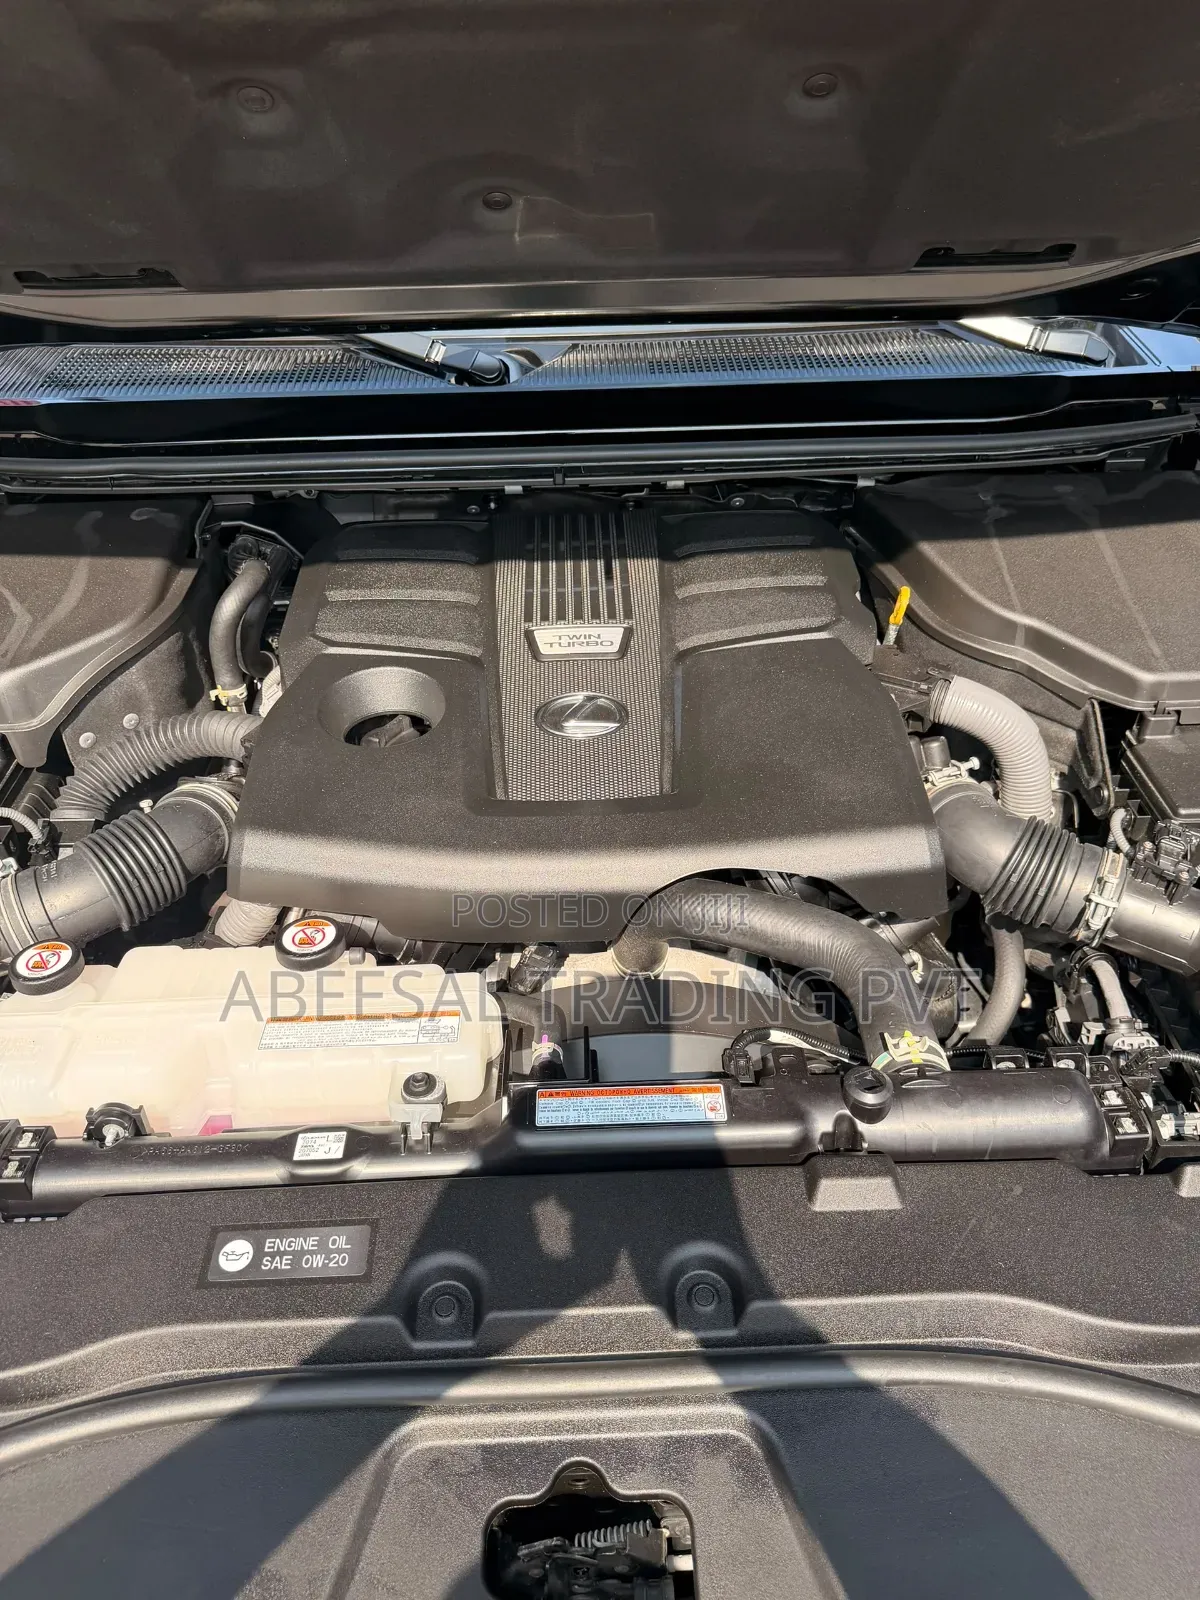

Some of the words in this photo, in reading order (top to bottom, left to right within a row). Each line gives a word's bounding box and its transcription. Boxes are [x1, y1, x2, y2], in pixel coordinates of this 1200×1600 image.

[552, 633, 602, 641] TWIN
[543, 640, 615, 648] TURBO
[264, 1237, 320, 1252] ENGINE
[328, 1235, 352, 1249] OIL
[261, 1255, 293, 1270] SAE
[302, 1253, 349, 1268] 0W-20
